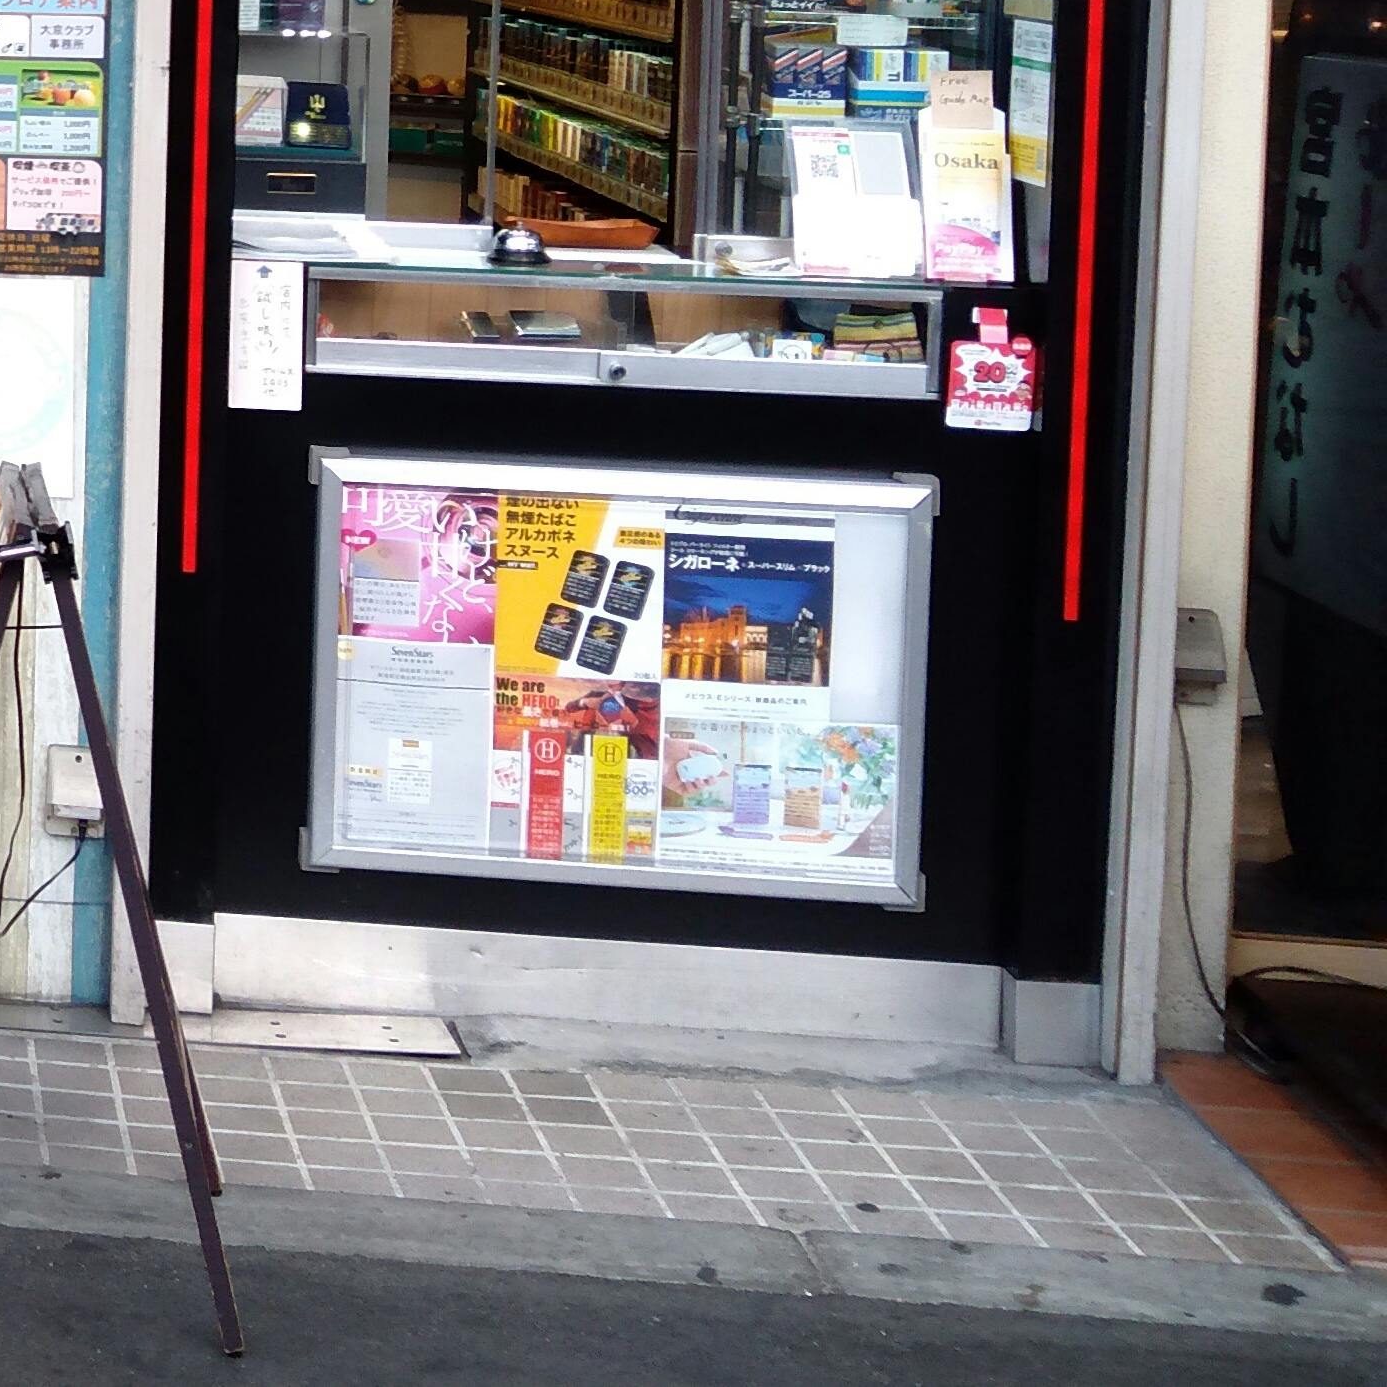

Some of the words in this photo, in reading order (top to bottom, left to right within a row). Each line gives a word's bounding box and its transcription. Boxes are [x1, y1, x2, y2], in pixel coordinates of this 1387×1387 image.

[39, 24, 95, 37] 大京クラブ
[933, 151, 1000, 171] Osaka
[505, 510, 577, 527] 無煙たばこ
[504, 544, 560, 559] スヌース
[668, 553, 740, 573] シガローネ
[496, 677, 519, 692] We
[522, 680, 546, 694] are
[496, 693, 519, 707] the
